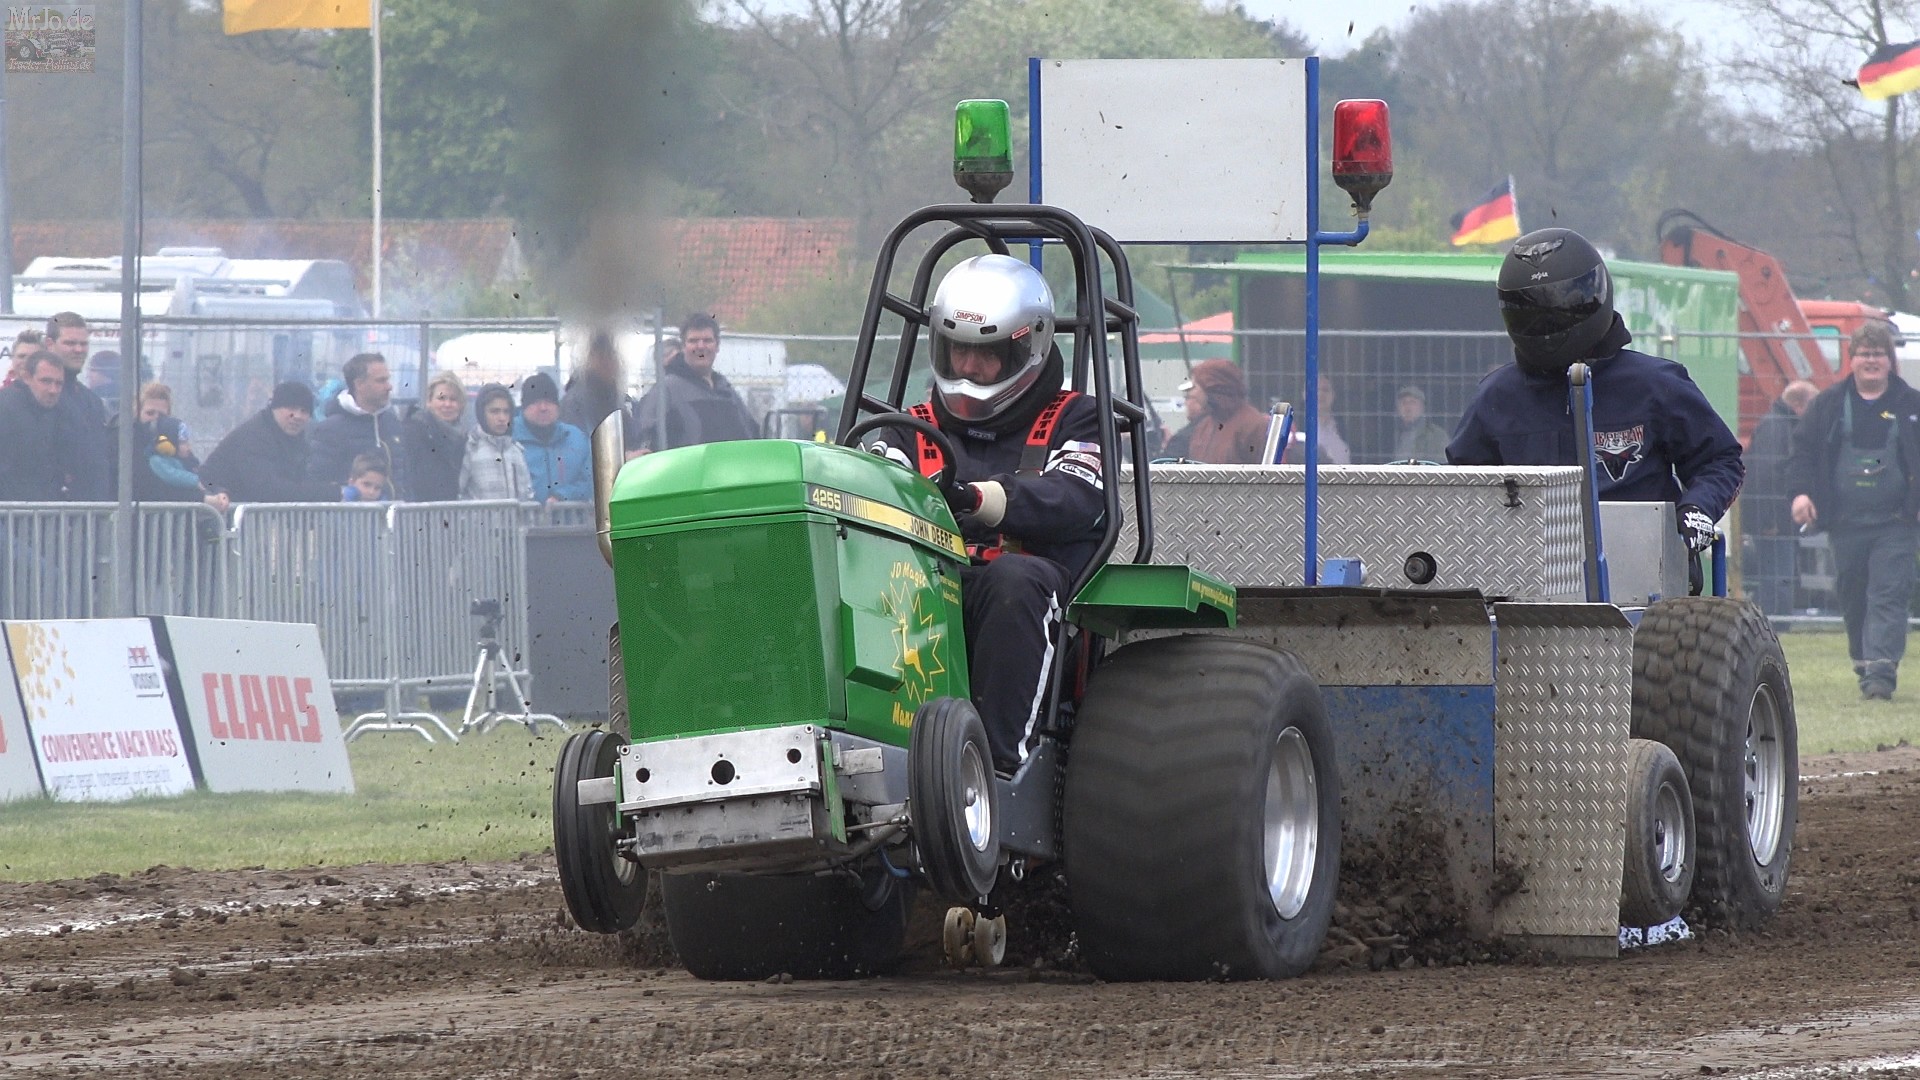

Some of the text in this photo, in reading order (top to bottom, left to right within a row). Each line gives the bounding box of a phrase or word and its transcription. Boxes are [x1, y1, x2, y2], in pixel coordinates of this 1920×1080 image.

[955, 311, 984, 323] SIMPSON
[812, 488, 842, 511] 4255
[910, 517, 954, 550] JOHN DEERE
[890, 562, 901, 579] JD
[902, 561, 927, 588] Magic
[202, 672, 322, 743] CLAAS
[41, 731, 118, 763] CONVENIENCE
[116, 729, 149, 759] NACH
[146, 728, 178, 758] MASS
